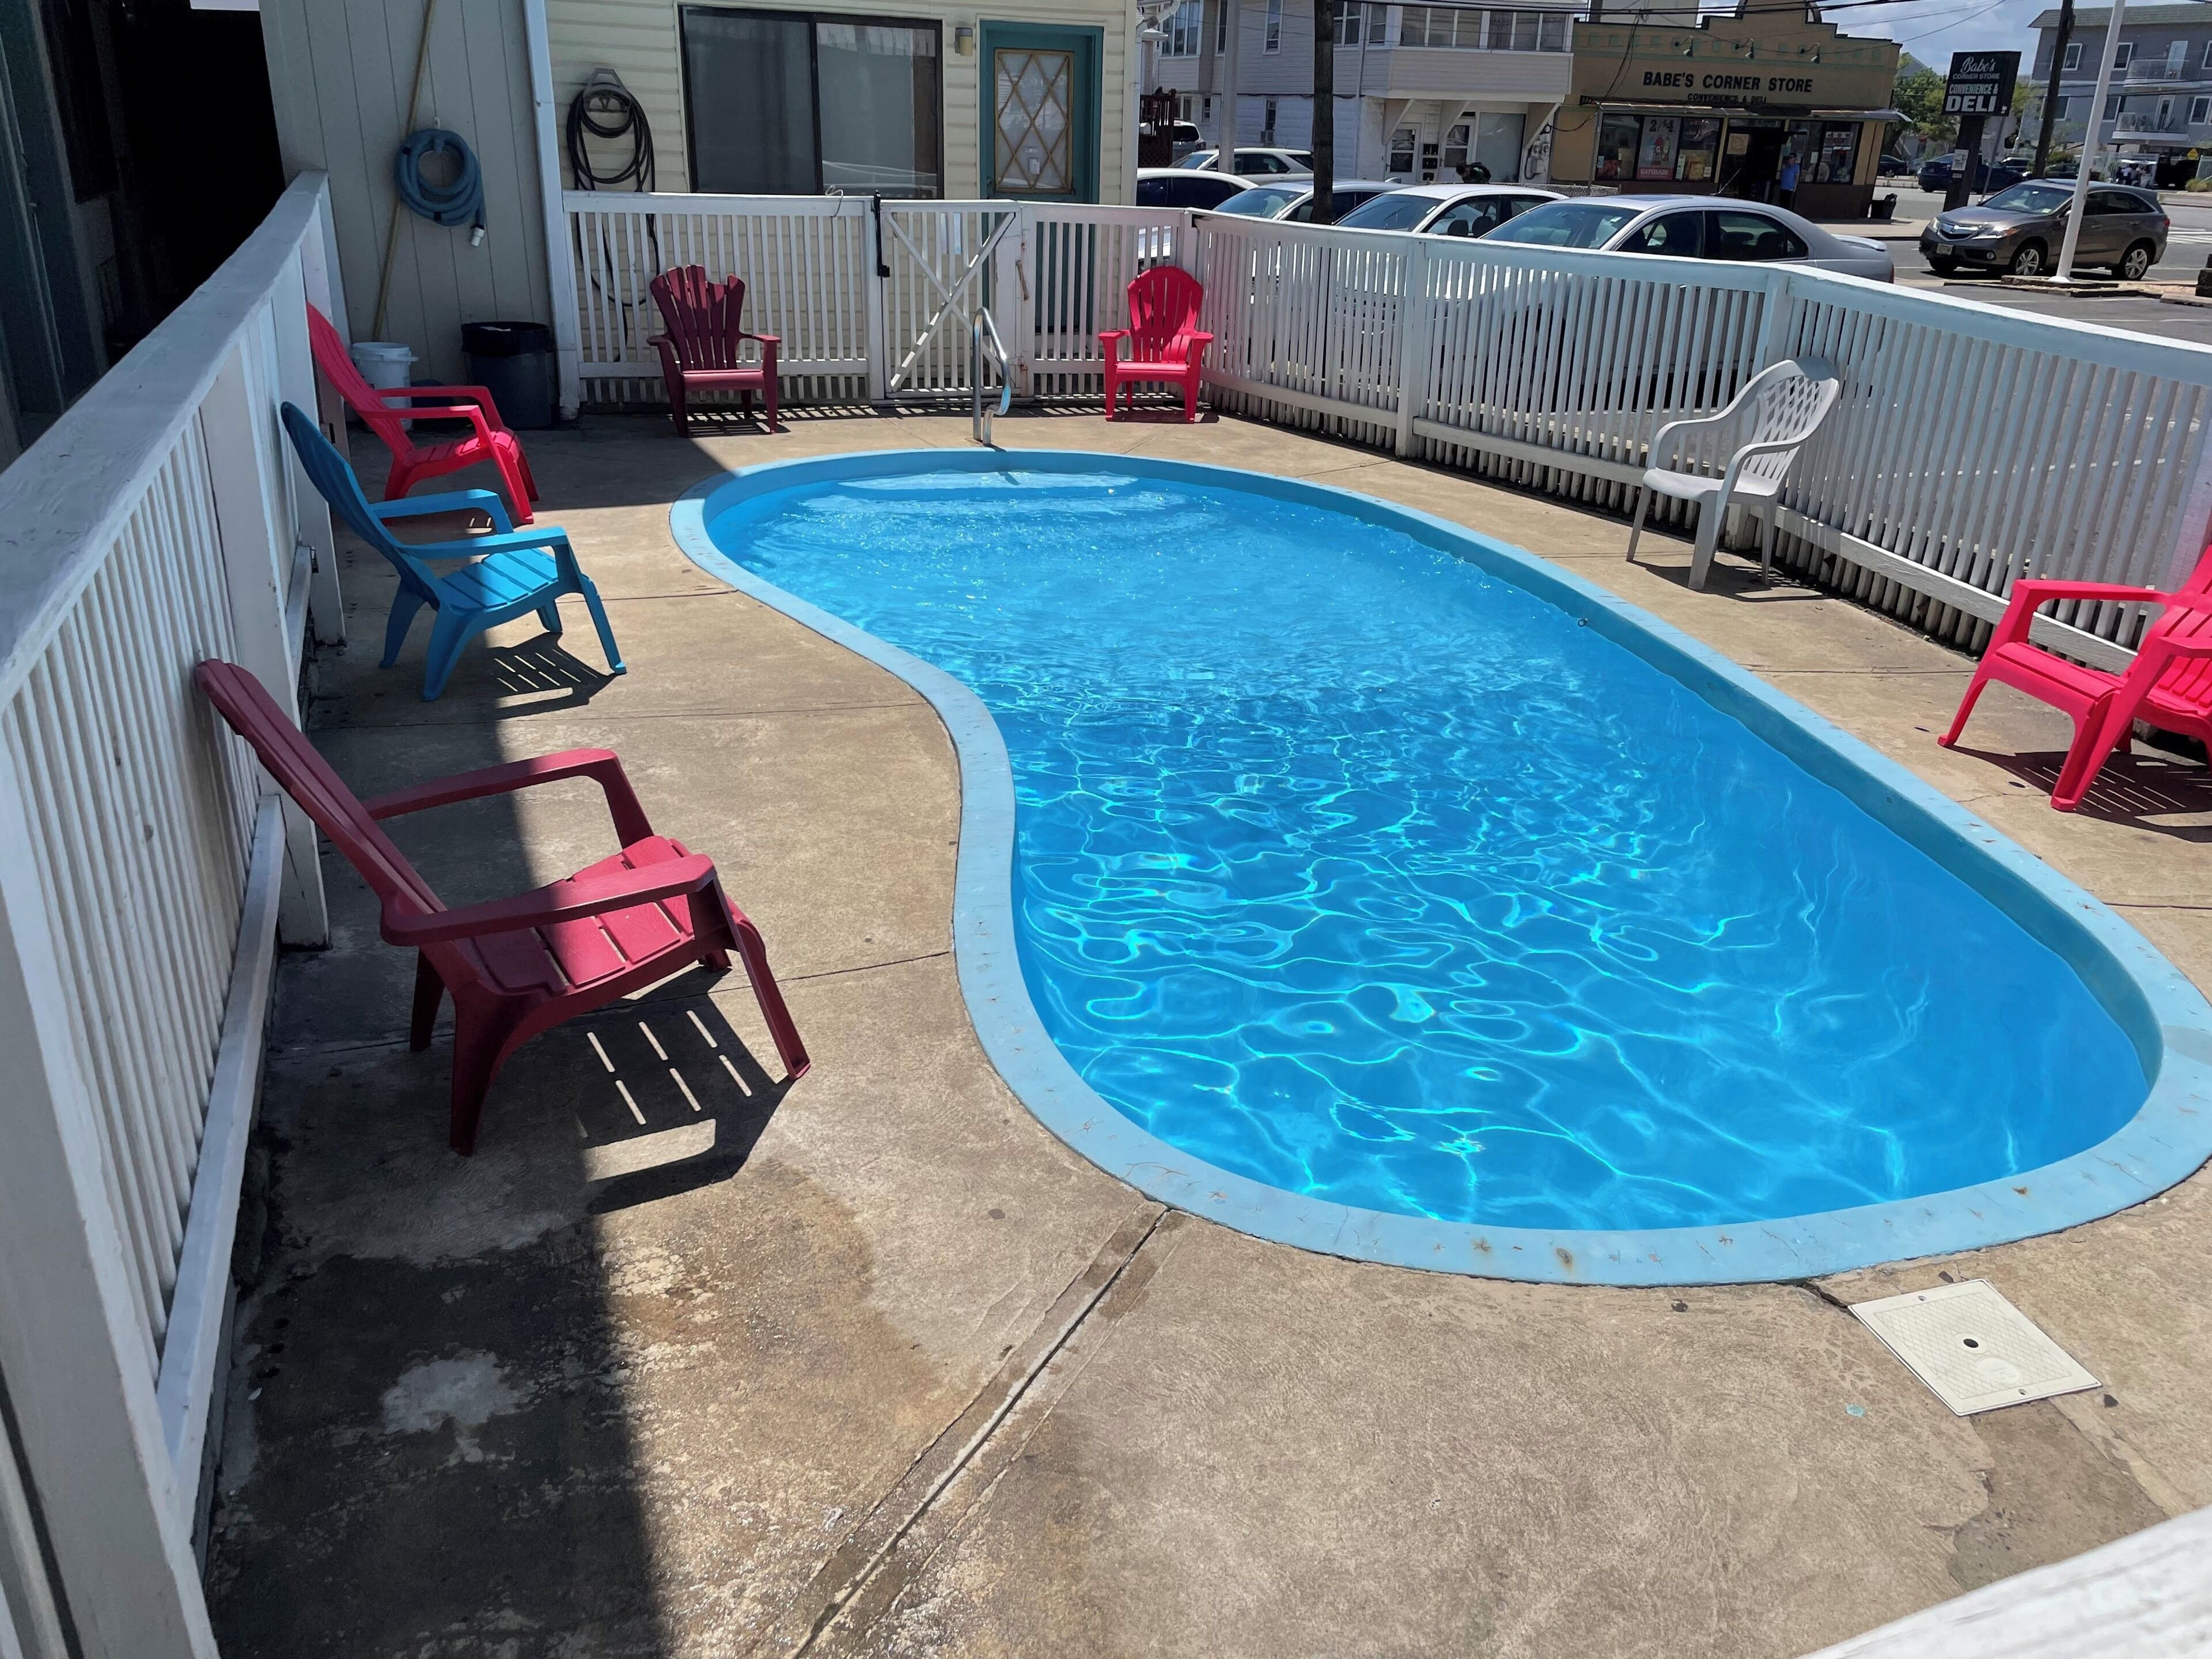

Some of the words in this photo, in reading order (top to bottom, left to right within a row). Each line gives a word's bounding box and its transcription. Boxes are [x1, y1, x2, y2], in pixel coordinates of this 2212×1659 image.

[1960, 56, 1996, 73] Babe's
[1643, 71, 1694, 87] BABE'S
[1703, 75, 1760, 90] CORNER
[1768, 78, 1813, 92] STORE
[1949, 84, 1993, 94] CONVENIENCE
[1993, 83, 1998, 94] &
[1945, 95, 1997, 112] DELI
